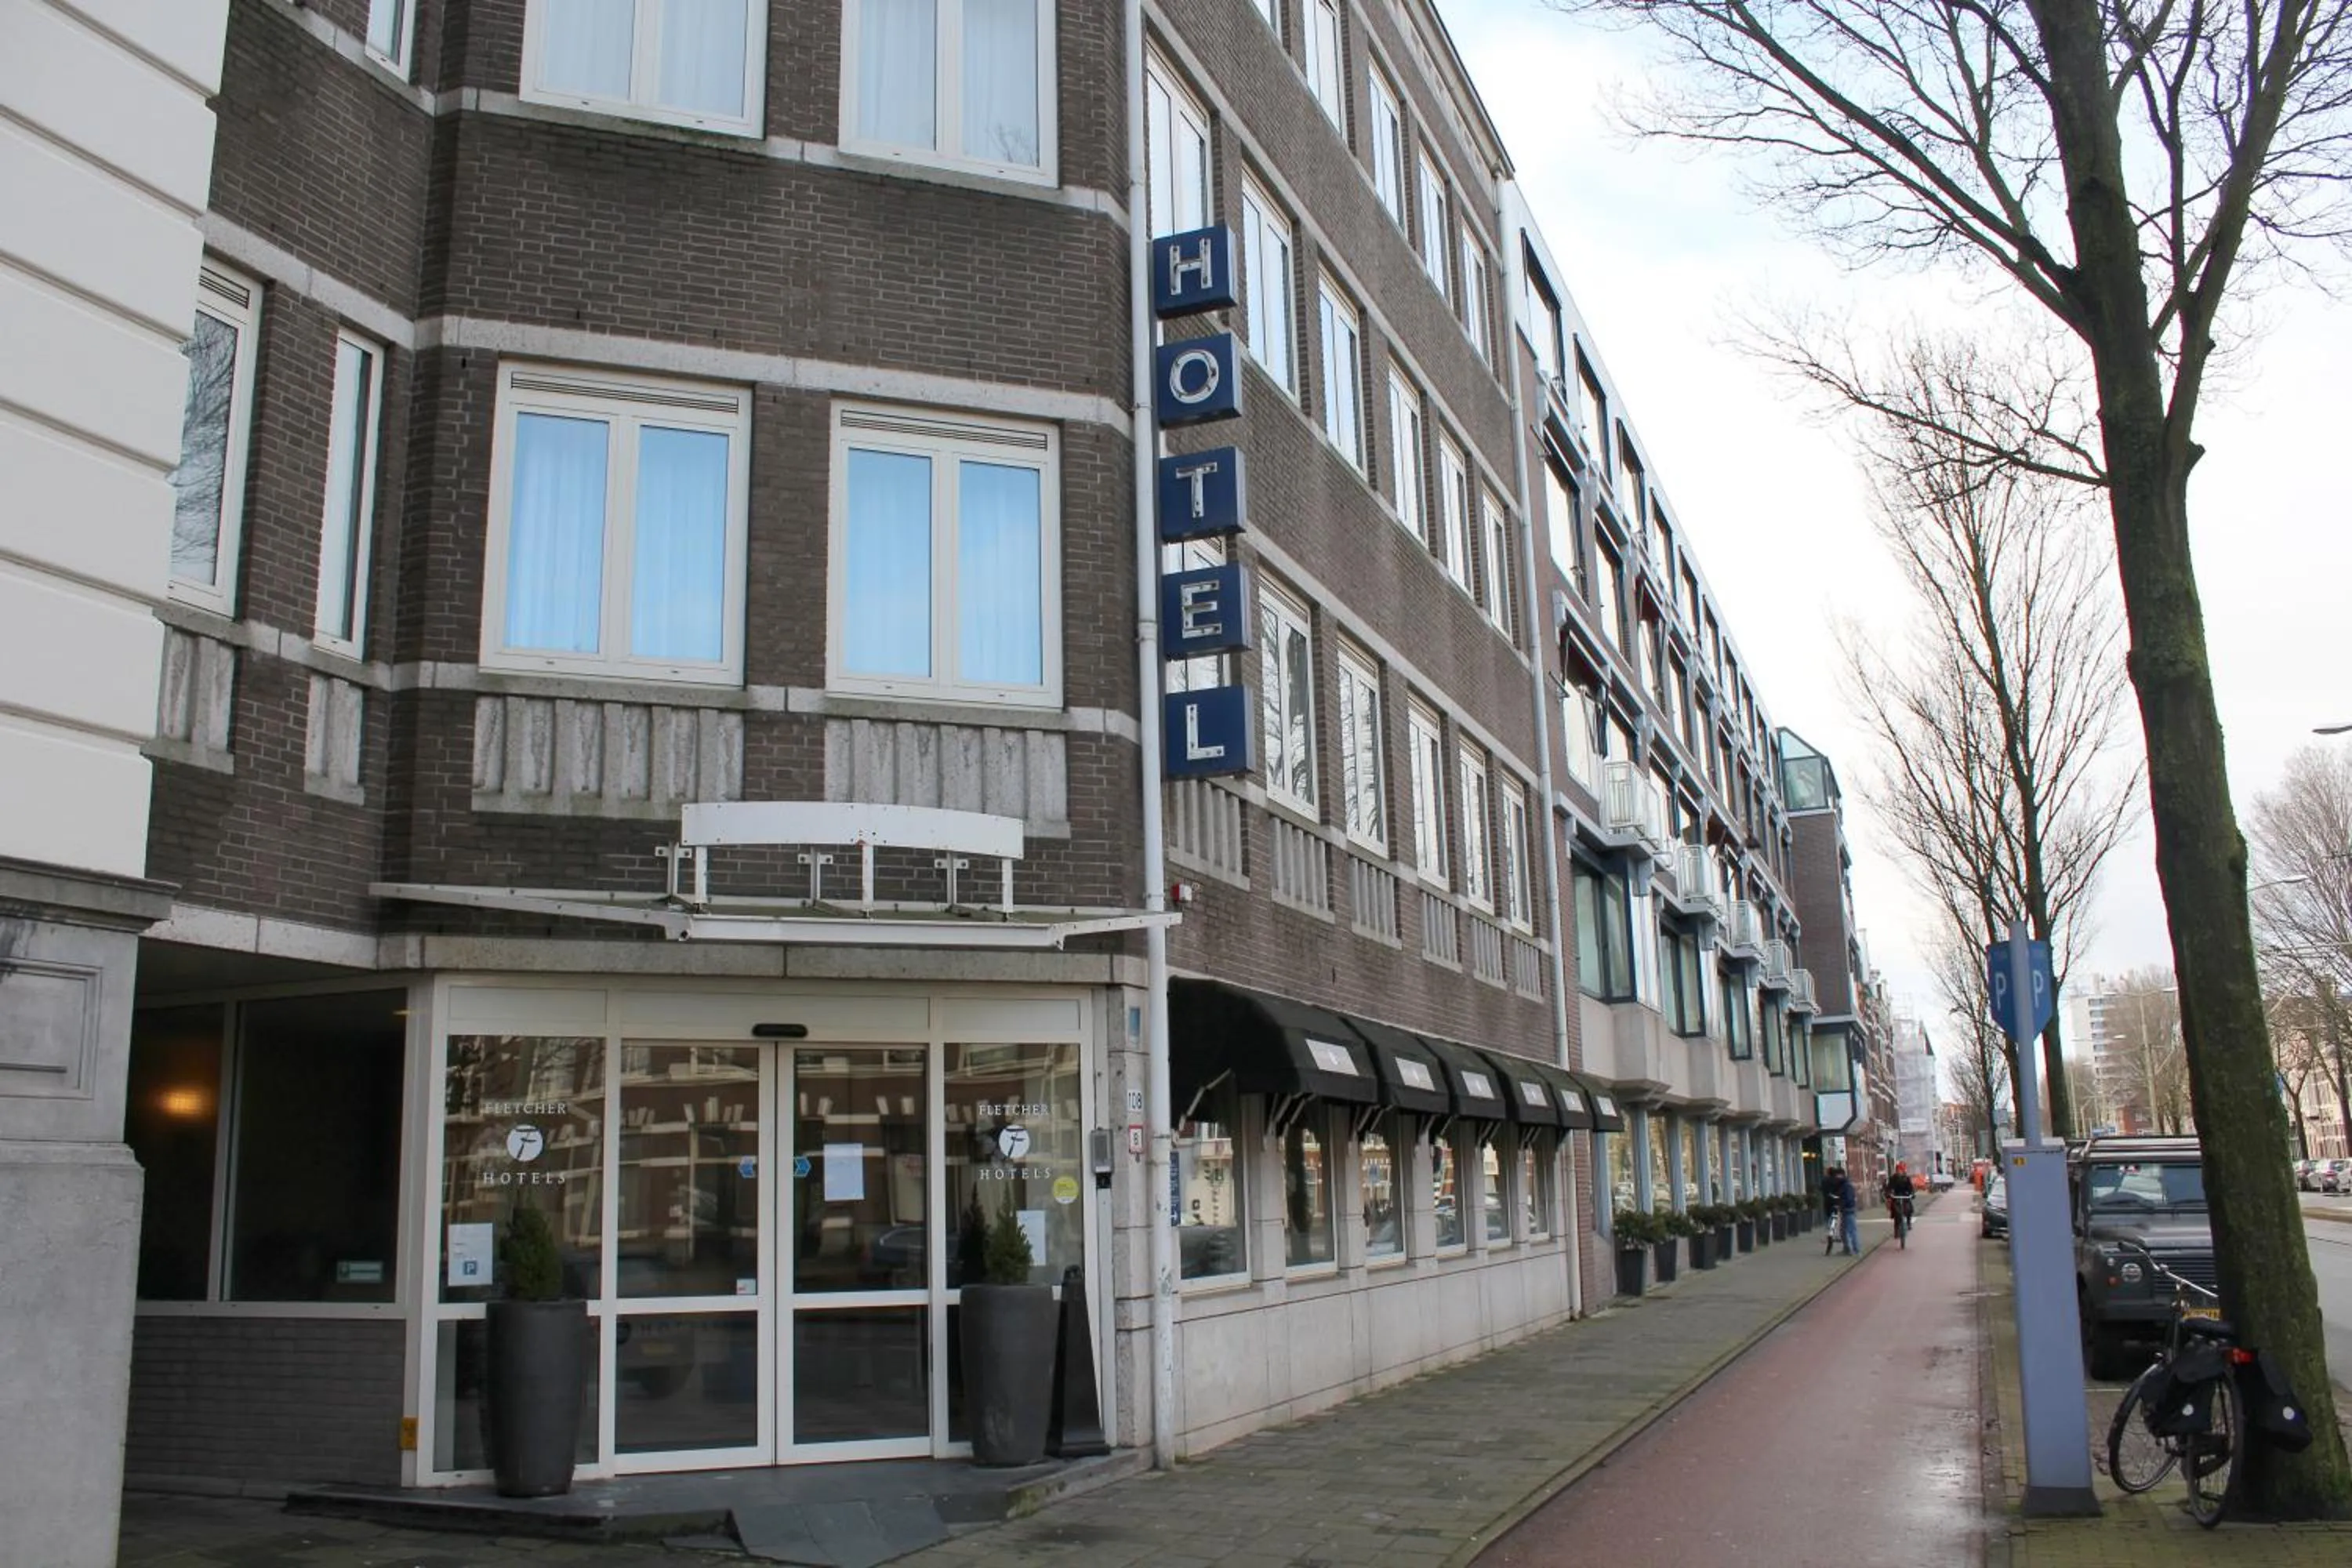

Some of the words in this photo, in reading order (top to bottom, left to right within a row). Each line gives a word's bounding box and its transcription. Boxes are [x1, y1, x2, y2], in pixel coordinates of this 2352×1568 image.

[1169, 237, 1225, 761] HOTEL
[1994, 973, 2006, 1011] P
[2033, 970, 2044, 1008] P
[484, 1102, 566, 1114] FLETCHER
[978, 1103, 1049, 1116] FLETCHER
[482, 1172, 565, 1185] HOTELS
[979, 1167, 1051, 1180] HOTELS
